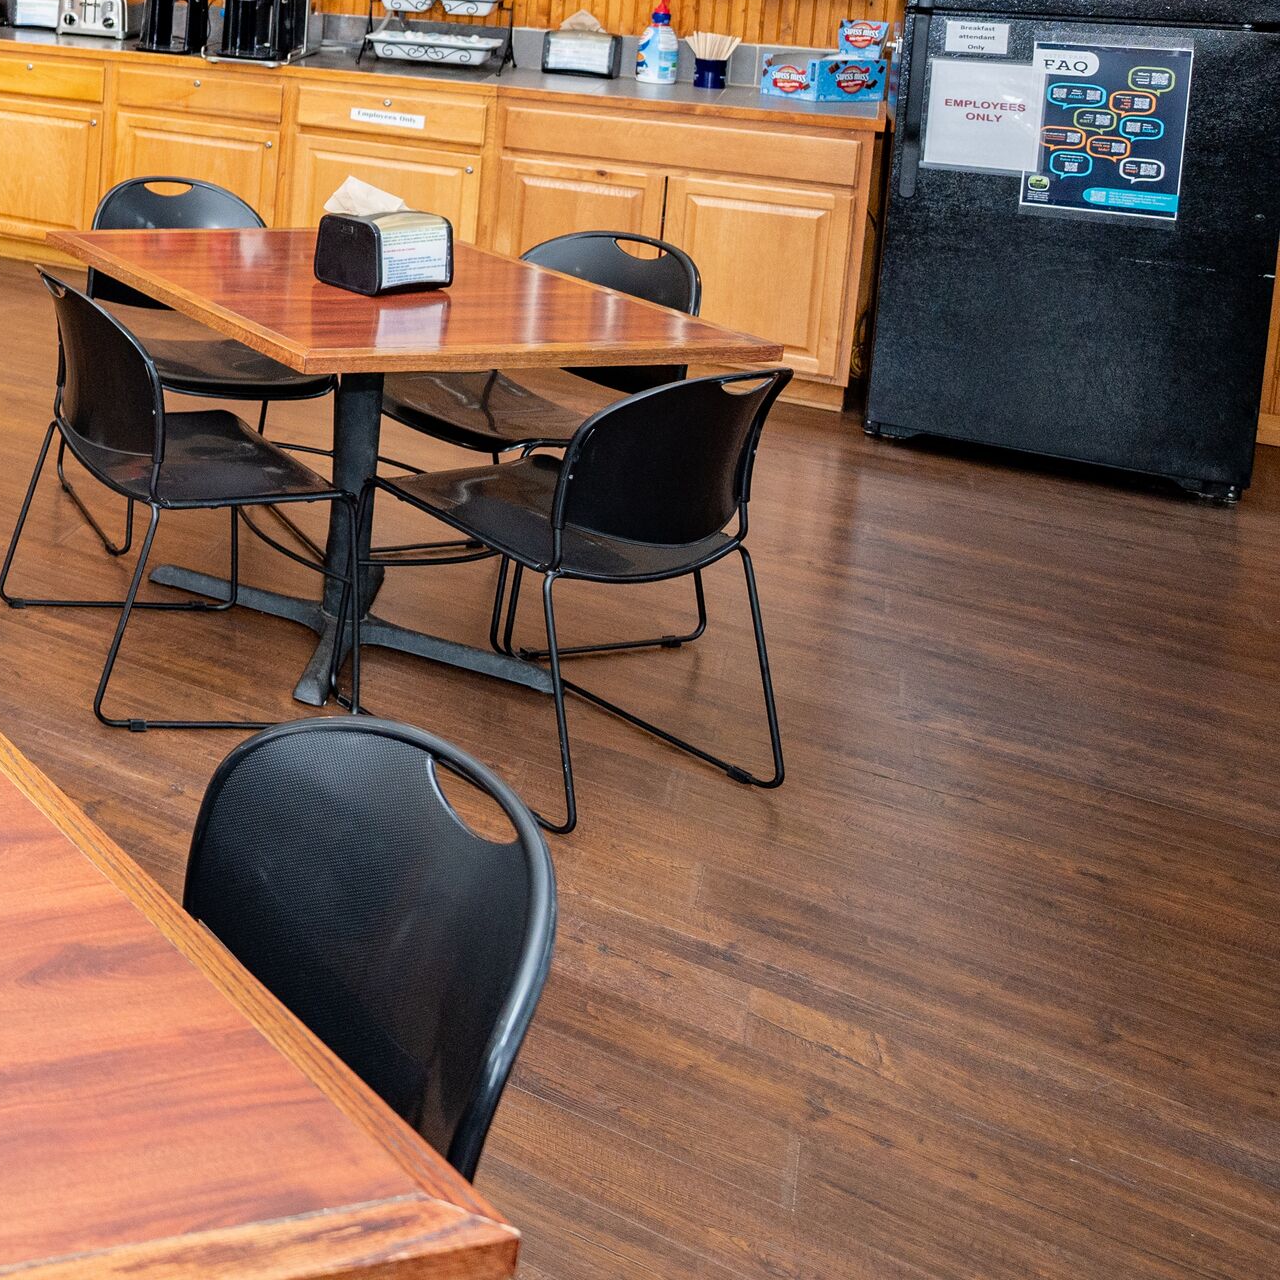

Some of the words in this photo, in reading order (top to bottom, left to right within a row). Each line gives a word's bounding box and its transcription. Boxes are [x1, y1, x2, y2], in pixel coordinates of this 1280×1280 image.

[967, 43, 985, 51] Only
[1043, 59, 1089, 74] FAQ
[944, 98, 1026, 112] EMPLOYEES
[357, 110, 397, 120] Employees
[399, 115, 416, 124] Only
[965, 112, 1002, 123] ONLY
